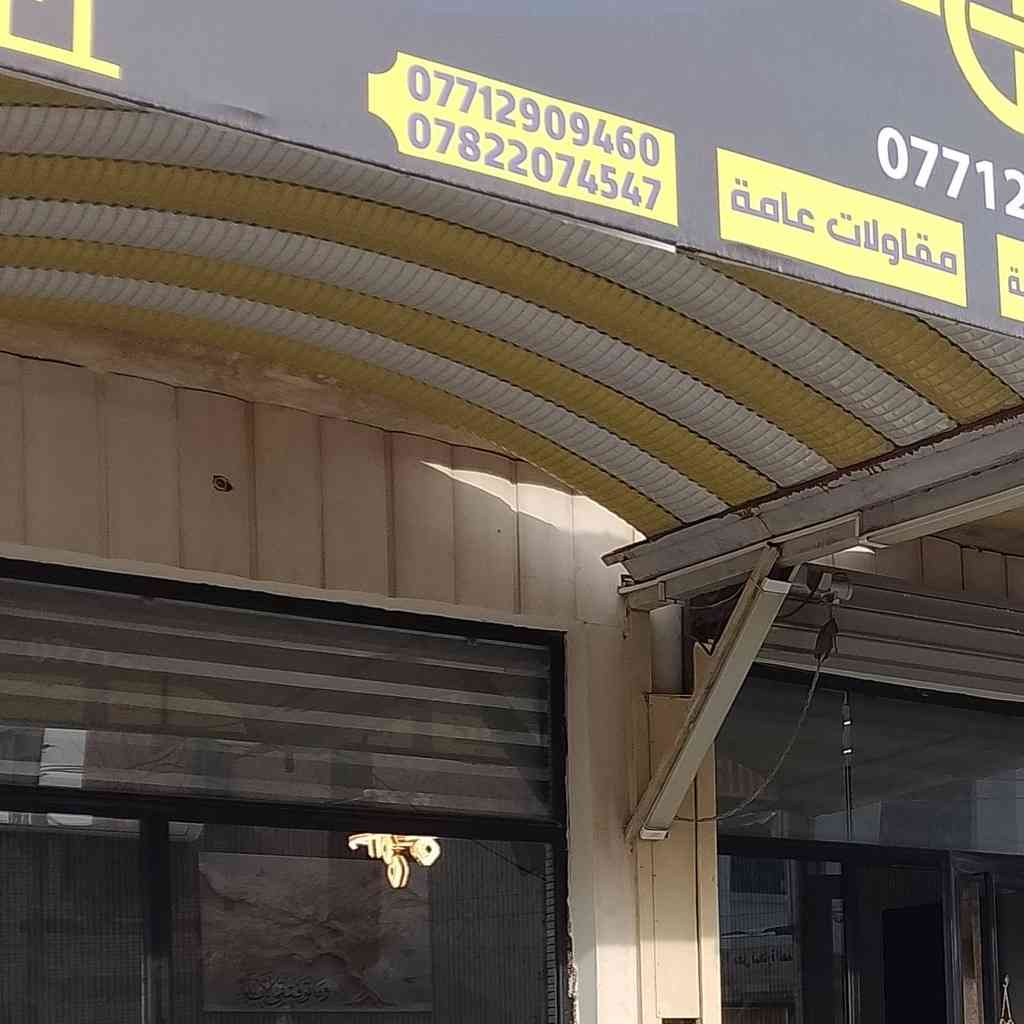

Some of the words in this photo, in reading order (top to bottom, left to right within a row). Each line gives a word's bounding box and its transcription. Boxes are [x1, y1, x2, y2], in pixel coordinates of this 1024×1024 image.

[407, 64, 660, 166] 07712909460
[407, 112, 661, 210] 07822074547
[730, 177, 815, 233] عامة
[826, 212, 958, 276] مقاولات
